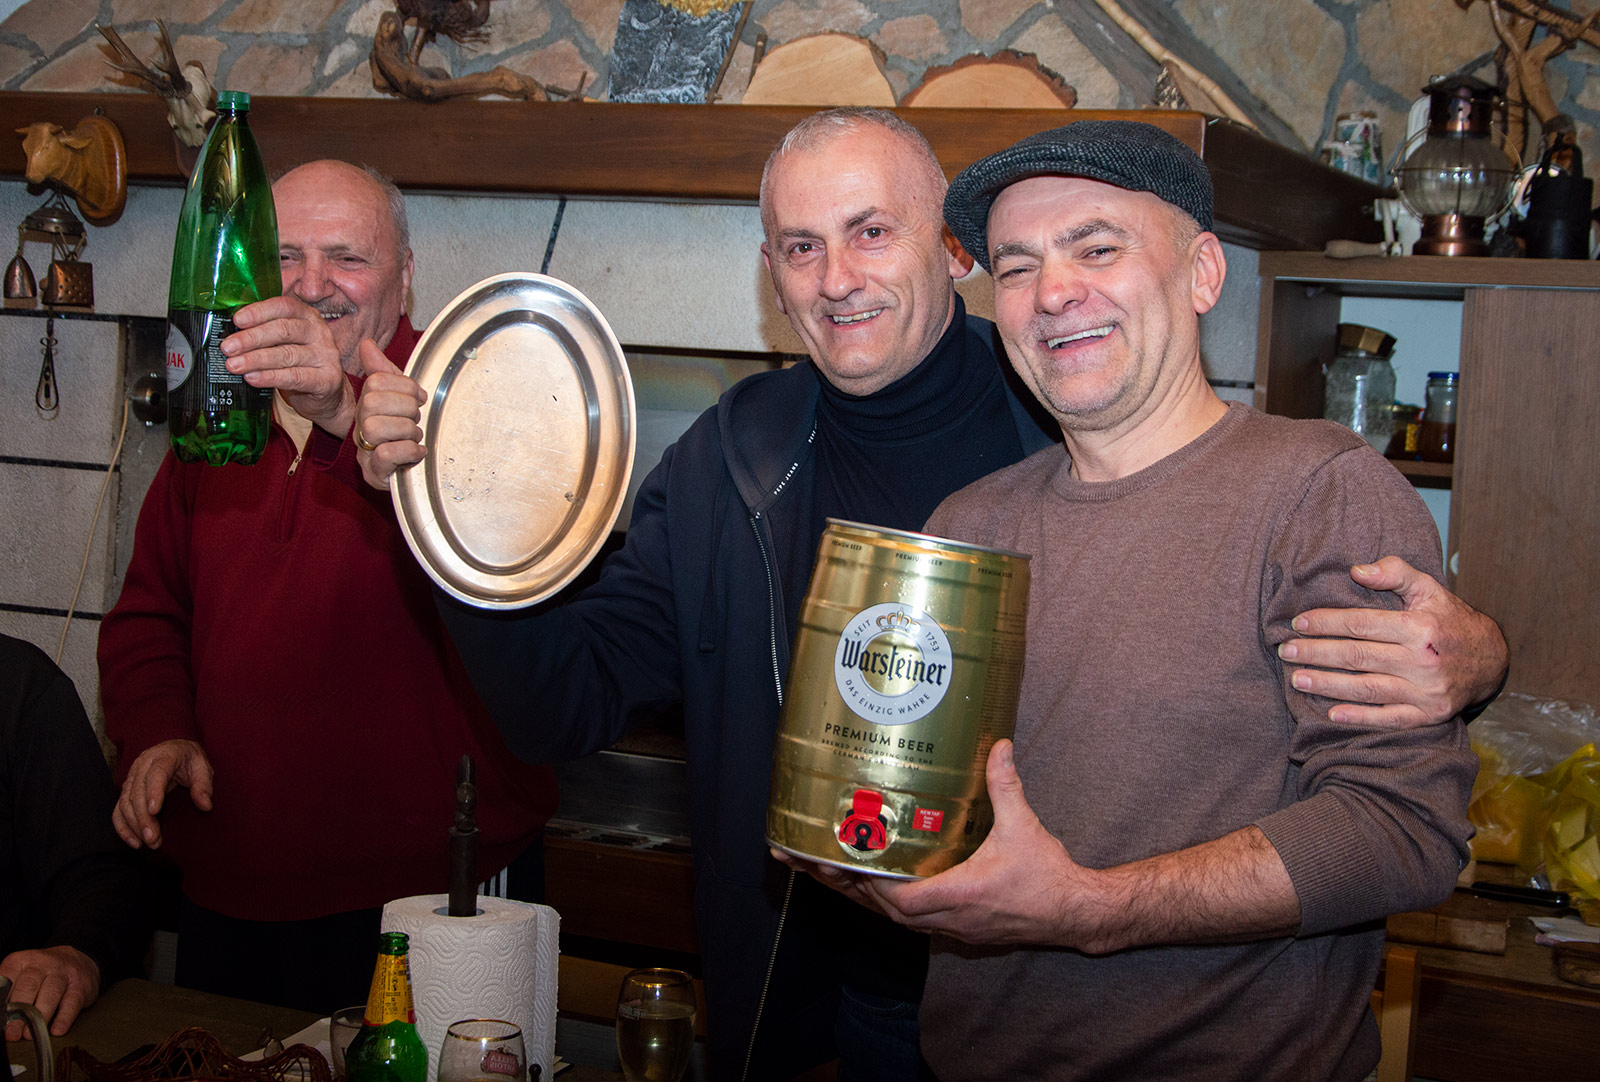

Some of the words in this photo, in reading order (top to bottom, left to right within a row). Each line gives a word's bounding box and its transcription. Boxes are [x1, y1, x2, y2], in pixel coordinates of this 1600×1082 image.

[773, 481, 785, 495] PEPE
[785, 462, 798, 480] JEANS
[896, 552, 924, 564] PREMIU
[854, 619, 871, 637] SEIT
[925, 631, 940, 652] 1753
[841, 637, 947, 686] Warsteiner
[845, 679, 859, 697] DAS
[859, 697, 893, 716] EINZIG
[898, 692, 931, 714] WAHRE
[821, 738, 850, 750] BREWED
[853, 745, 900, 760] ACCORDING
[904, 754, 915, 762] TO
[918, 757, 934, 766] THE
[824, 722, 891, 746] PREMIUM
[898, 738, 934, 754] BEER
[832, 749, 865, 761] GERMAN
